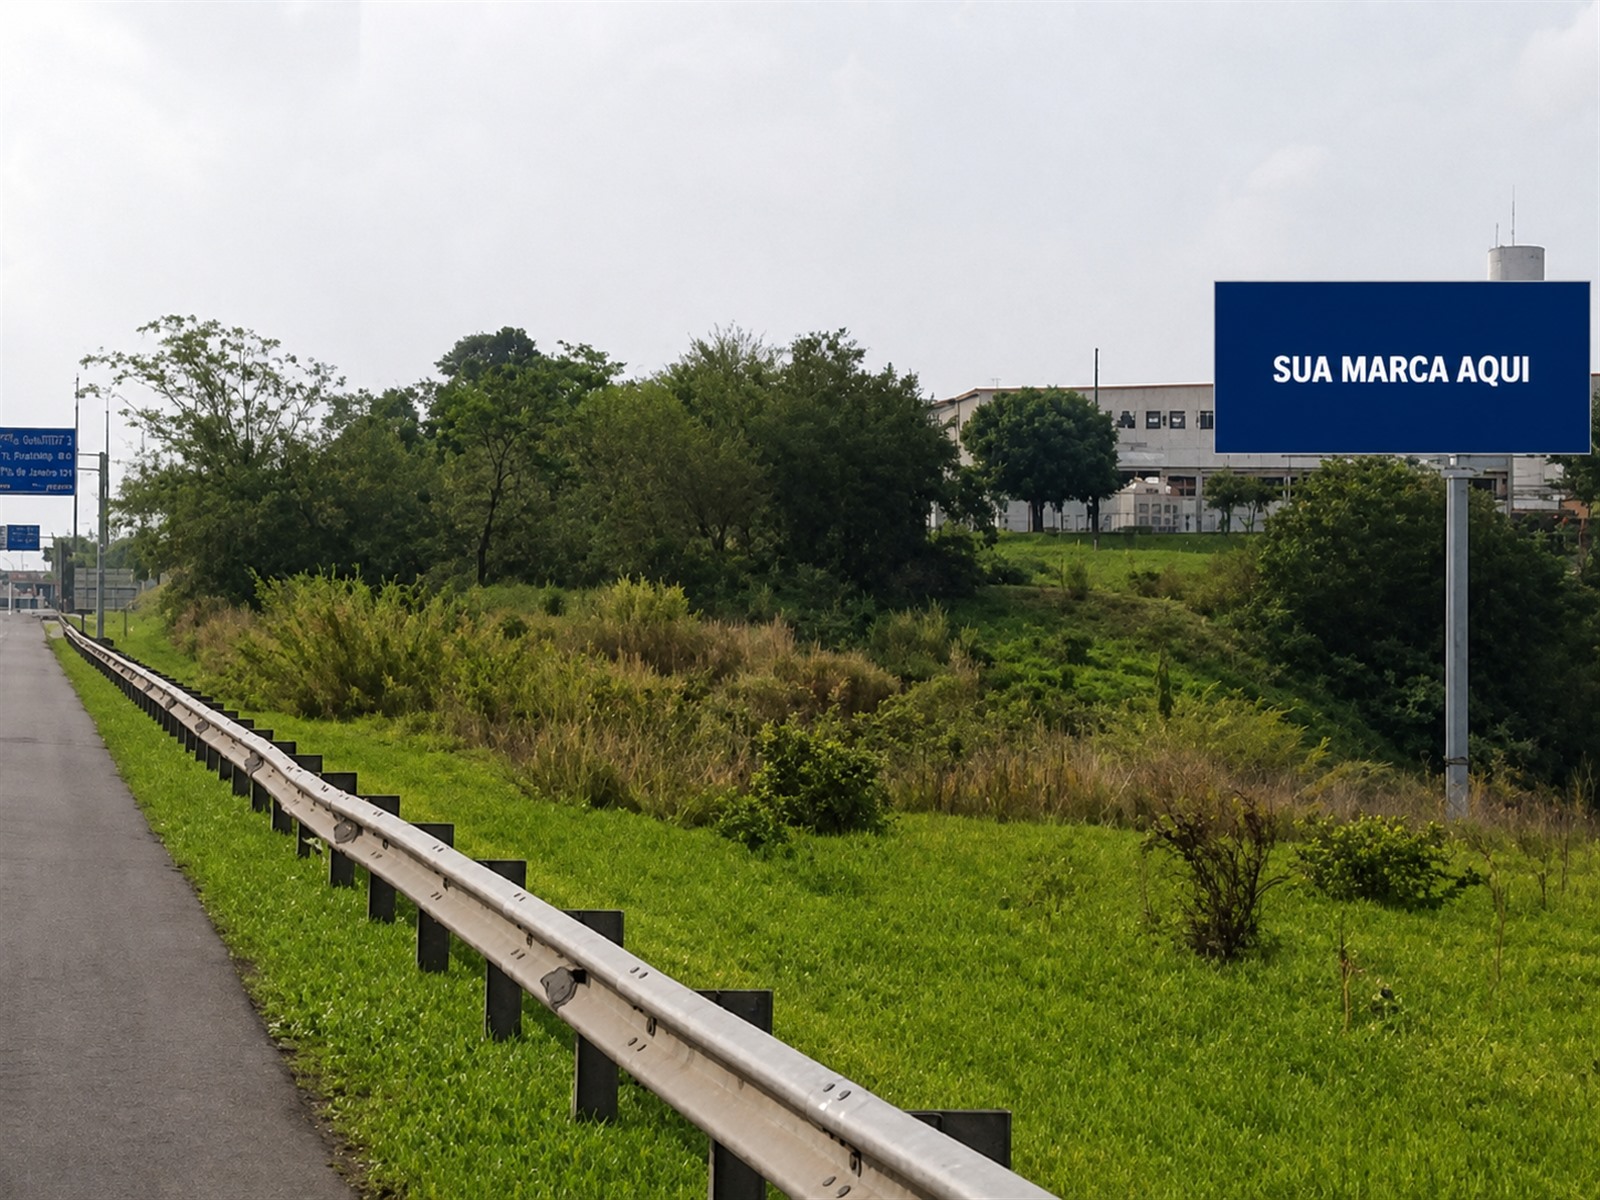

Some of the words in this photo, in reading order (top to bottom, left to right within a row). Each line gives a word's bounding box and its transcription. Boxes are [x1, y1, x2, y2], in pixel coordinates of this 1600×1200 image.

[1273, 355, 1332, 383] SUA
[1341, 355, 1448, 383] MARCA
[1456, 355, 1529, 387] AQUI
